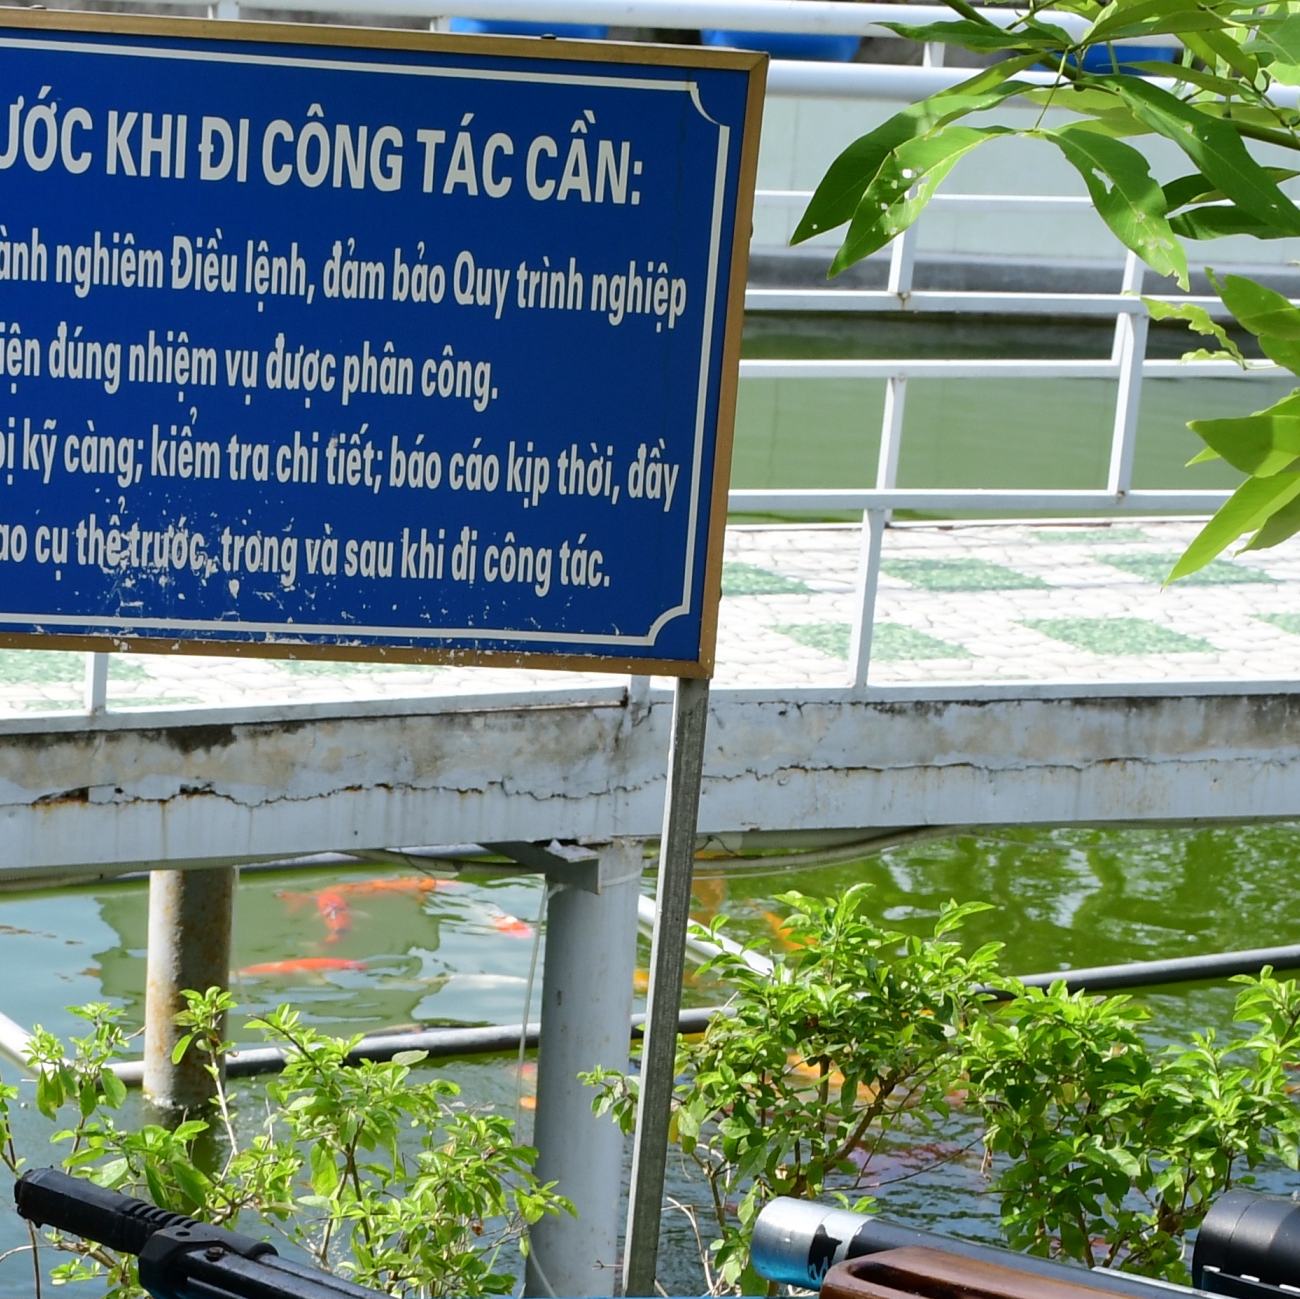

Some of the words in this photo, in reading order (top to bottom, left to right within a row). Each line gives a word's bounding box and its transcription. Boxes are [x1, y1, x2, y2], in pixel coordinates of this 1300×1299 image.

[107, 111, 187, 178] KHI
[199, 117, 249, 182] ĐI
[263, 104, 402, 191] CÔNG
[417, 114, 513, 197] TÁC
[527, 110, 642, 204] CẦN:
[56, 232, 163, 297] nghiêm
[171, 229, 237, 292] Điều
[246, 240, 314, 312] lệnh,
[324, 238, 384, 301] đảm
[393, 242, 445, 303] bảo
[454, 251, 509, 319] Quy
[517, 256, 583, 309] trình
[591, 261, 686, 332] nghiệp
[49, 322, 121, 393] đúng
[129, 331, 216, 401] nhiệm
[226, 350, 258, 404] vụ
[266, 333, 335, 408] được
[343, 341, 413, 405] phân
[422, 345, 497, 411] công.
[23, 418, 57, 483] kỹ
[65, 421, 143, 487] càng;
[152, 407, 220, 478] kiểm
[227, 435, 268, 481] tra
[277, 431, 318, 483] chi
[326, 424, 382, 493] tiết;
[390, 434, 441, 489] báo
[450, 438, 499, 492] cáo
[507, 441, 549, 508] kịp
[558, 443, 619, 504] thời,
[628, 439, 678, 511] đầy
[36, 525, 67, 580] cụ
[76, 496, 123, 567] thể
[221, 527, 297, 588] trong
[305, 524, 338, 576] và
[345, 540, 393, 578] sau
[401, 528, 444, 579] khi
[484, 532, 549, 596] công
[557, 534, 609, 586] tác.
